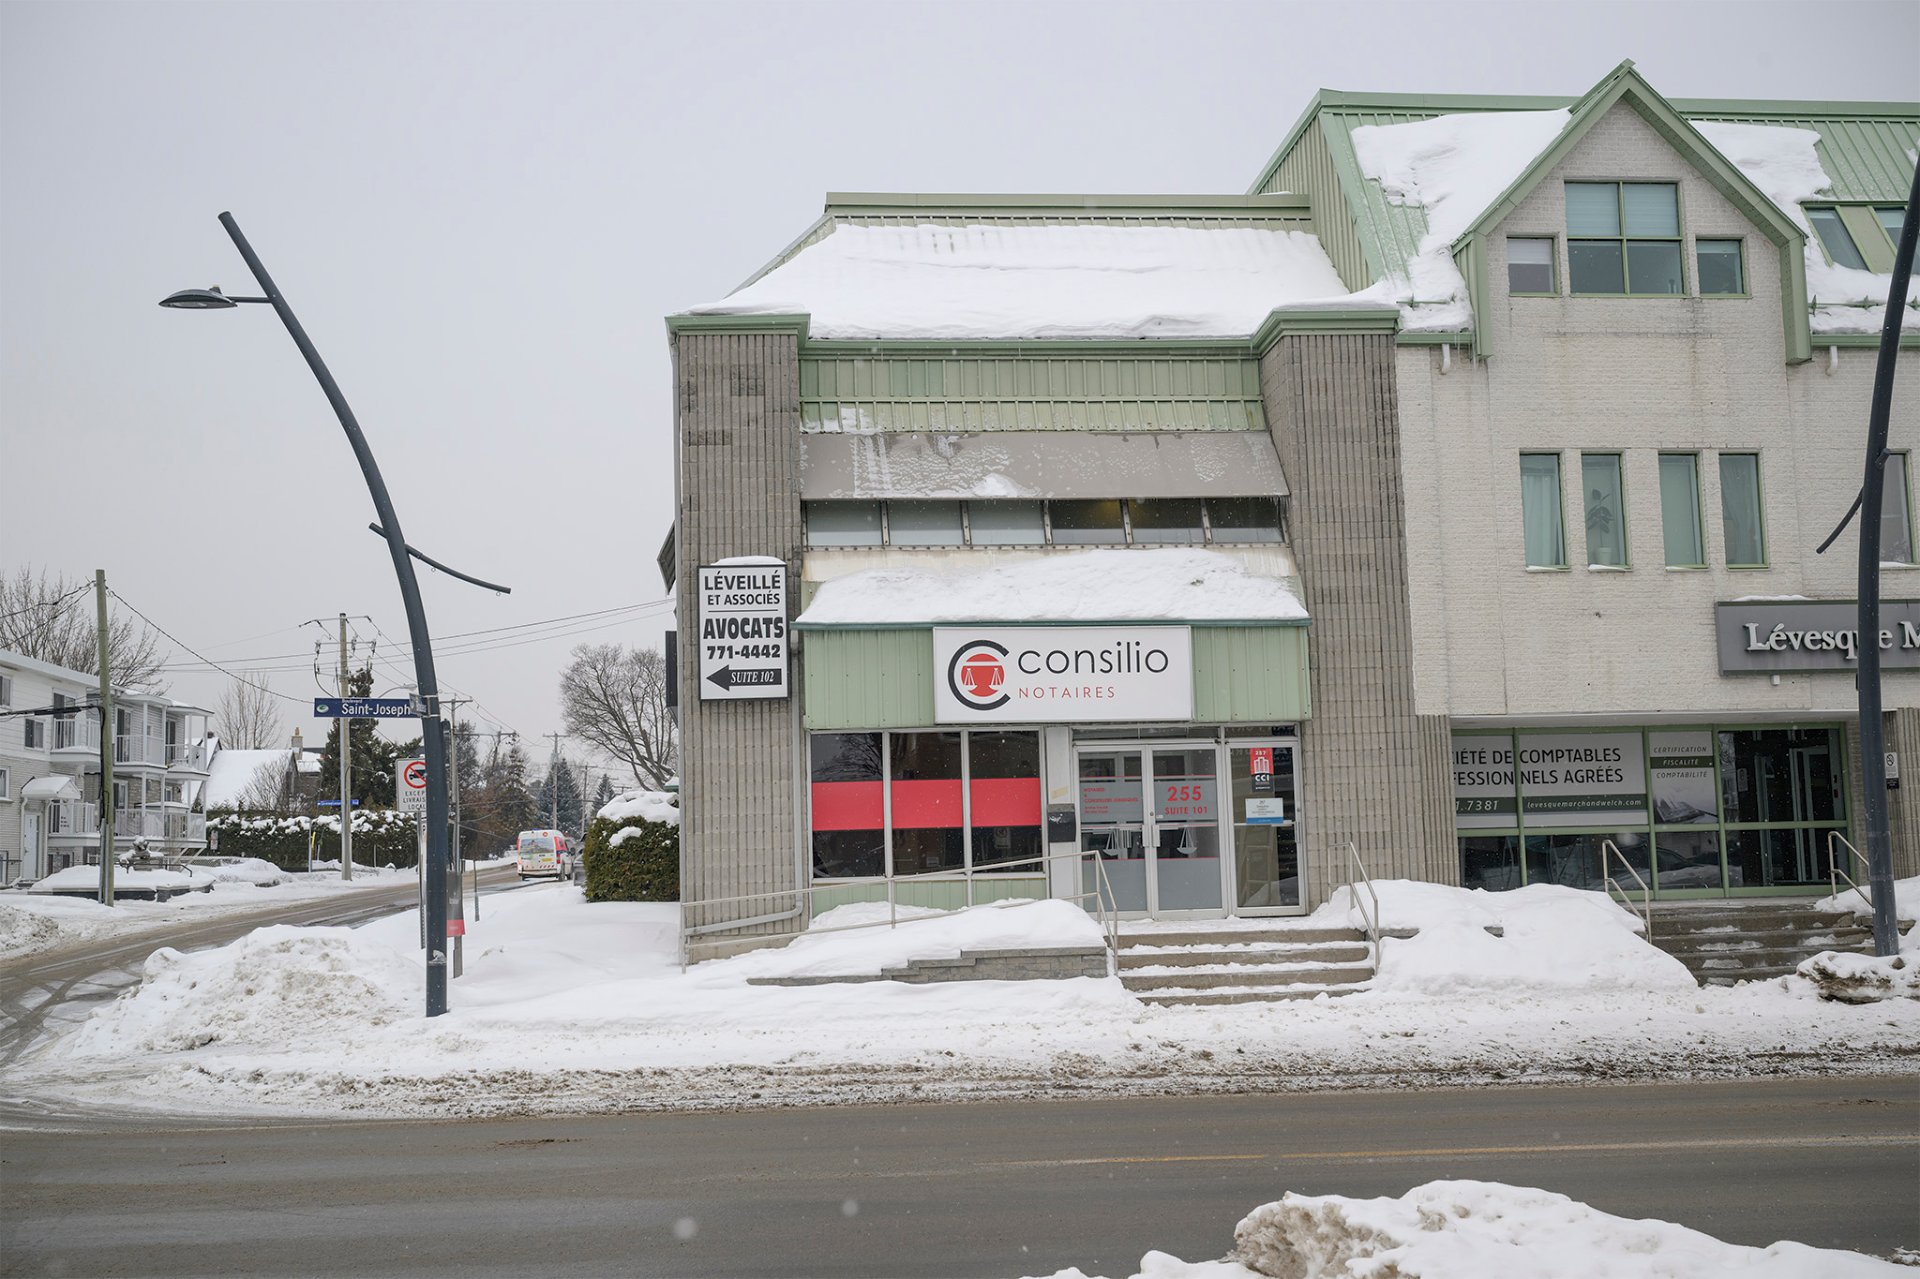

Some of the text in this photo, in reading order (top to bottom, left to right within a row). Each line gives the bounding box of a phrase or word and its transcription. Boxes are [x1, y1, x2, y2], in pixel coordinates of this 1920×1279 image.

[704, 570, 781, 590] LÉVEILLÉ
[707, 590, 780, 605] ET ASSOCIÉS
[703, 617, 784, 639] AVOCATS
[1746, 623, 1893, 660] Lévesqe
[707, 644, 781, 660] 771-4442
[1017, 641, 1169, 675] consilio
[731, 671, 775, 683] SUITE 102
[1018, 687, 1116, 699] NOTAIRES
[341, 703, 411, 717] Saint-Joseph
[1452, 747, 1622, 765] IÉTÉ DE COMPTABLES
[1653, 746, 1707, 754] CERTIFICATION
[1662, 758, 1699, 766] FISCALITÉ
[1255, 774, 1270, 782] CCI
[1563, 766, 1624, 784] AGRÉÉS
[1656, 771, 1708, 779] COMPTABILITÉ
[1167, 785, 1202, 802] 255
[1164, 805, 1208, 815] SUITE 101
[1527, 799, 1642, 809] levesquemarchandwelch.com
